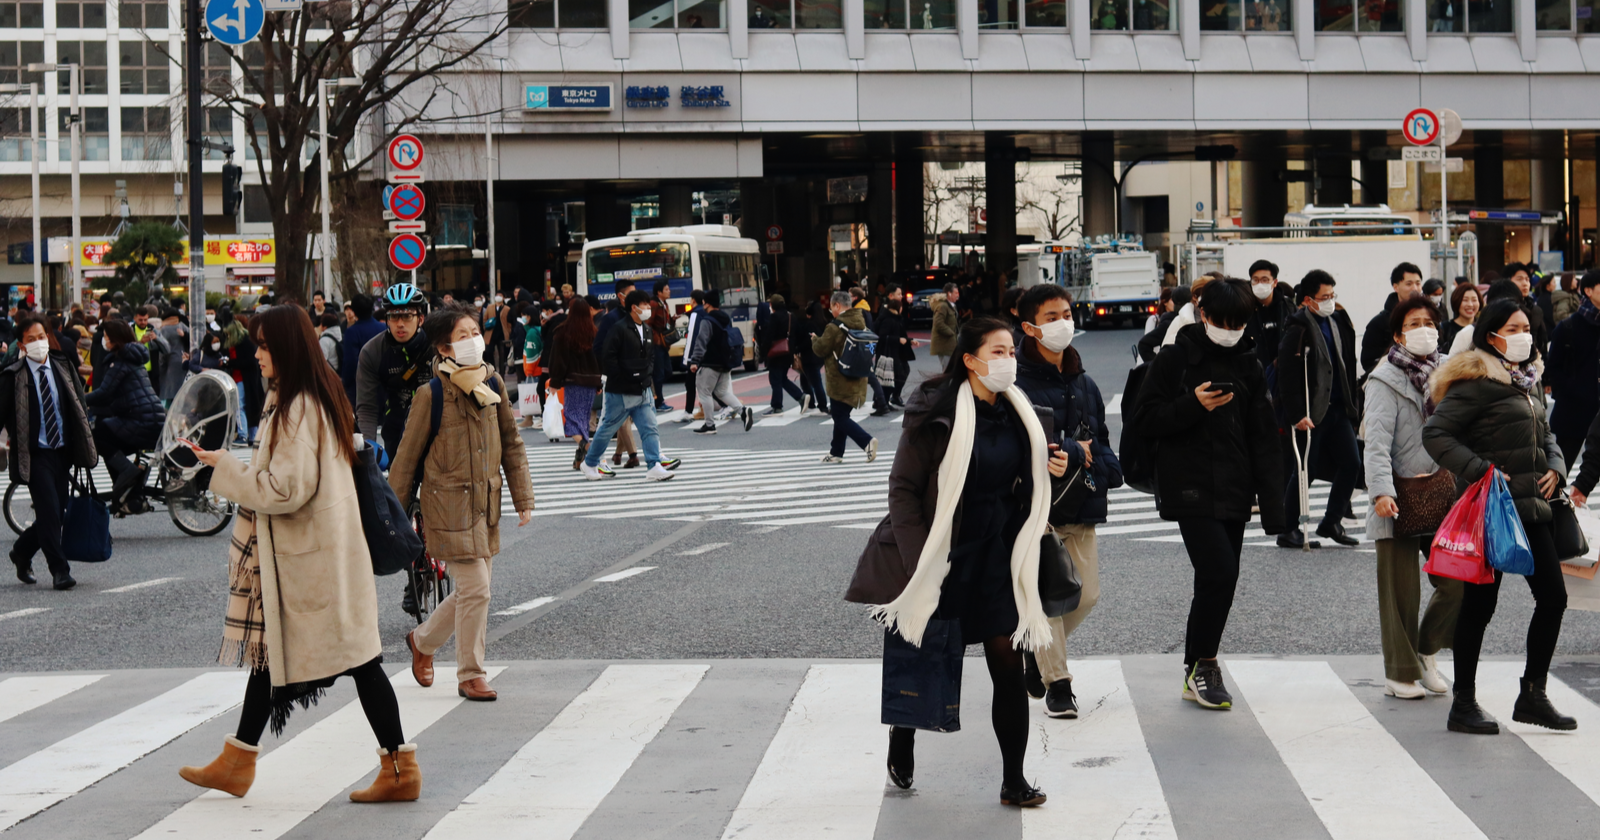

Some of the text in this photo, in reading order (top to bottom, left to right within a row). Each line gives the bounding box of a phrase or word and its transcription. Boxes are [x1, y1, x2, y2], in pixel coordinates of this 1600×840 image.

[561, 89, 597, 97] 東京メトロ
[681, 86, 724, 99] 渋谷駅
[626, 100, 651, 108] Ginza
[652, 100, 669, 108] Line
[681, 100, 714, 108] Shibuya
[1405, 150, 1437, 159] ここまで
[207, 241, 220, 255] 場
[229, 242, 270, 252] 大当たりの
